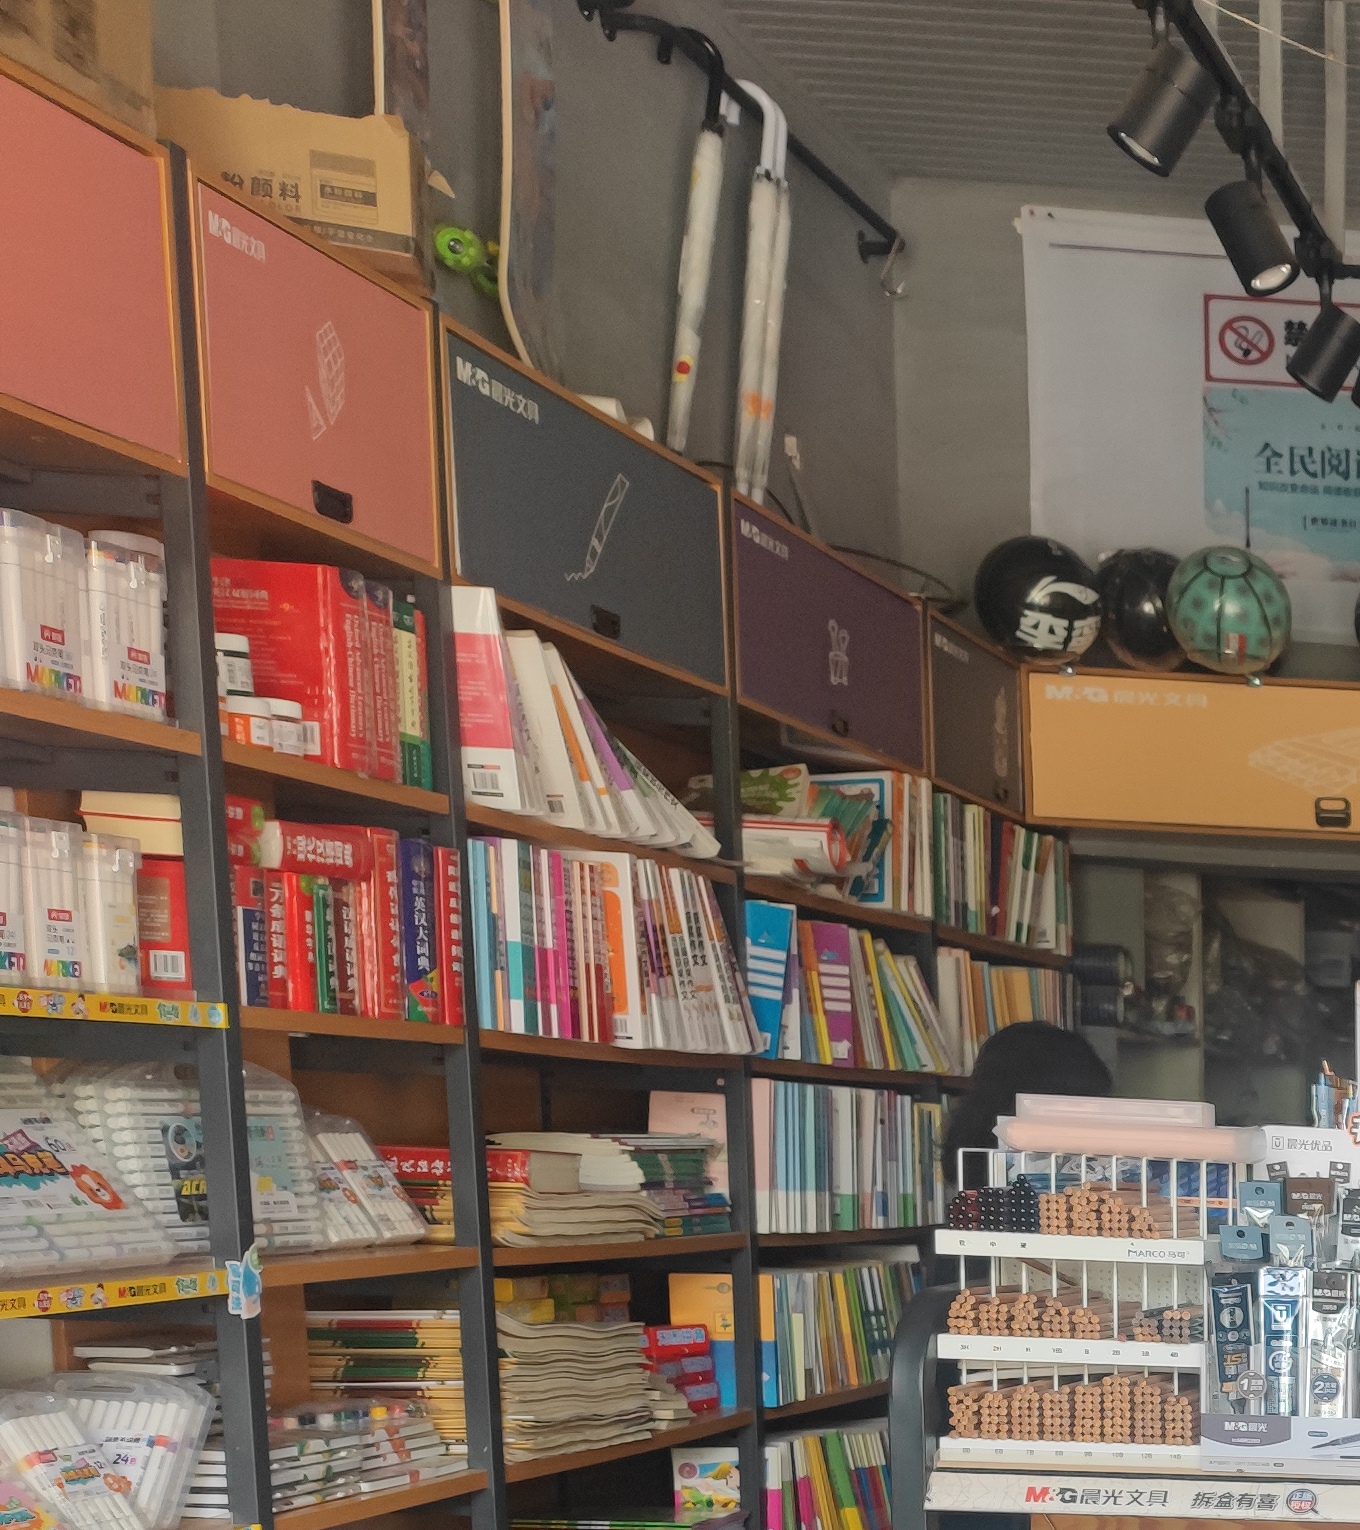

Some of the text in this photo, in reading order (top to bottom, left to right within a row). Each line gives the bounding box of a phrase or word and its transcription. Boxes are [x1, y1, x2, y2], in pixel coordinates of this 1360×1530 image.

[413, 896, 431, 973] 英汉大词典
[1286, 1137, 1334, 1152] 晨光优品
[1127, 1248, 1166, 1259] MARCO
[1223, 1420, 1269, 1433] M&G晨光
[1024, 1484, 1281, 1512] M&G晨光文具 拆盒有喜
